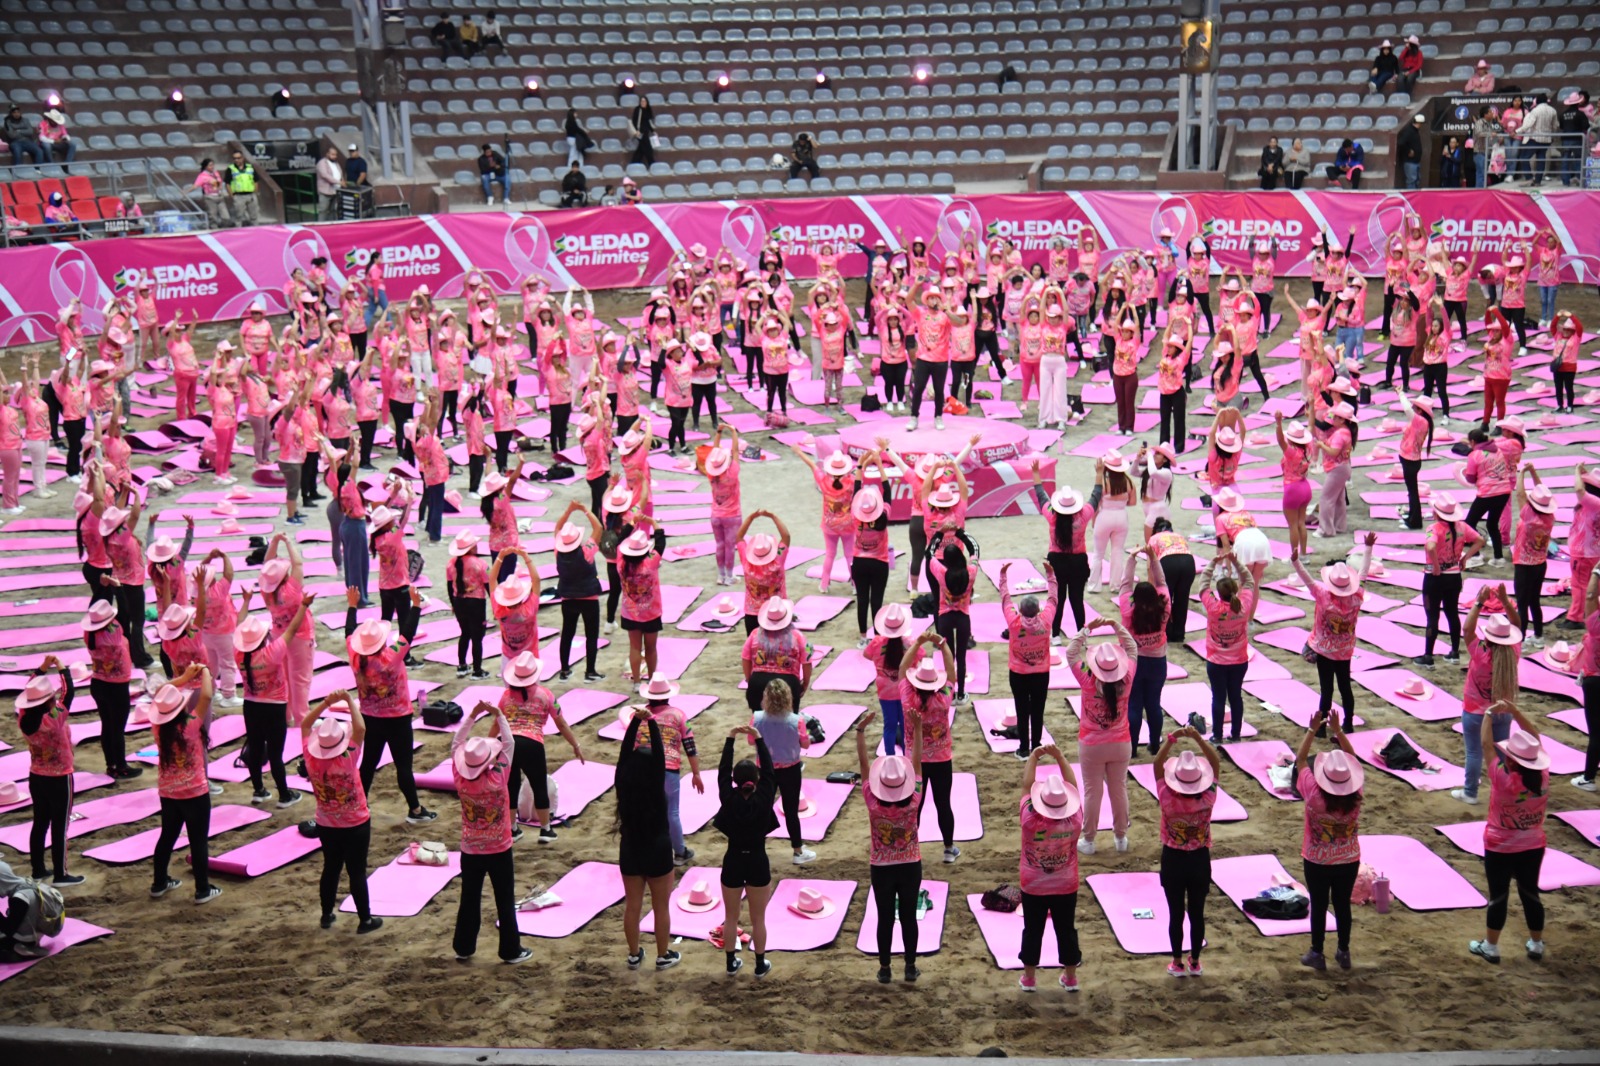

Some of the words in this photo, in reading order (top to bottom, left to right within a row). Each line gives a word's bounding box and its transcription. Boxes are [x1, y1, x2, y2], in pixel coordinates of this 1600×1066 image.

[770, 223, 865, 243] SOLEDAD
[986, 218, 1083, 239] SOLEDAD
[1202, 216, 1303, 238] SOLEDAD
[1431, 216, 1537, 240] SOLEDAD
[554, 232, 650, 256] SOLEDAD
[1212, 235, 1238, 250] sin
[565, 251, 590, 267] sin
